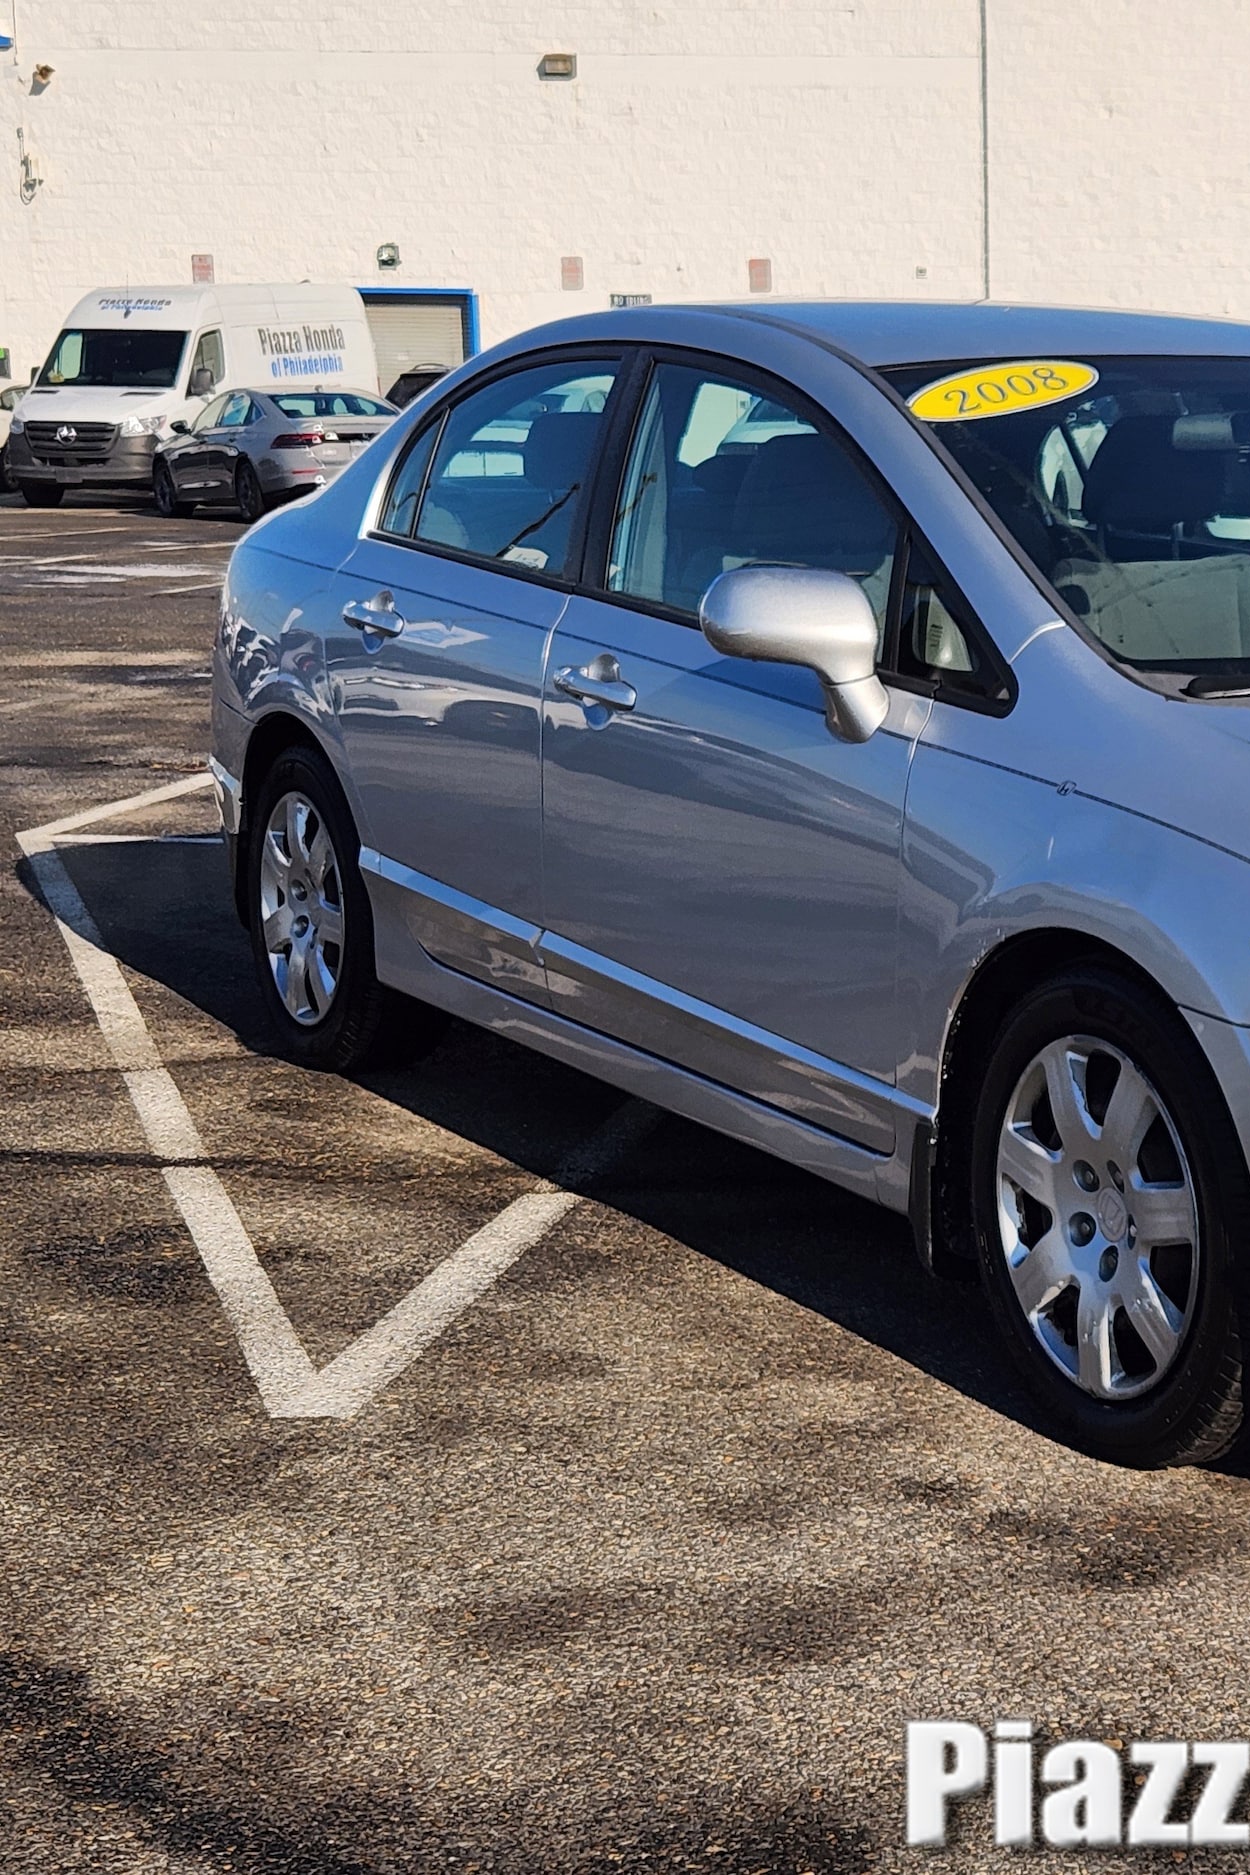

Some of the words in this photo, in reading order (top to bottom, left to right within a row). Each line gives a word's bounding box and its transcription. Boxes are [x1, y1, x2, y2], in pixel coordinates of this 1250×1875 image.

[258, 327, 303, 355] Piazza
[302, 323, 346, 352] Honda
[271, 357, 282, 378] of
[283, 354, 344, 377] Philadelphia
[944, 367, 1069, 413] 2008
